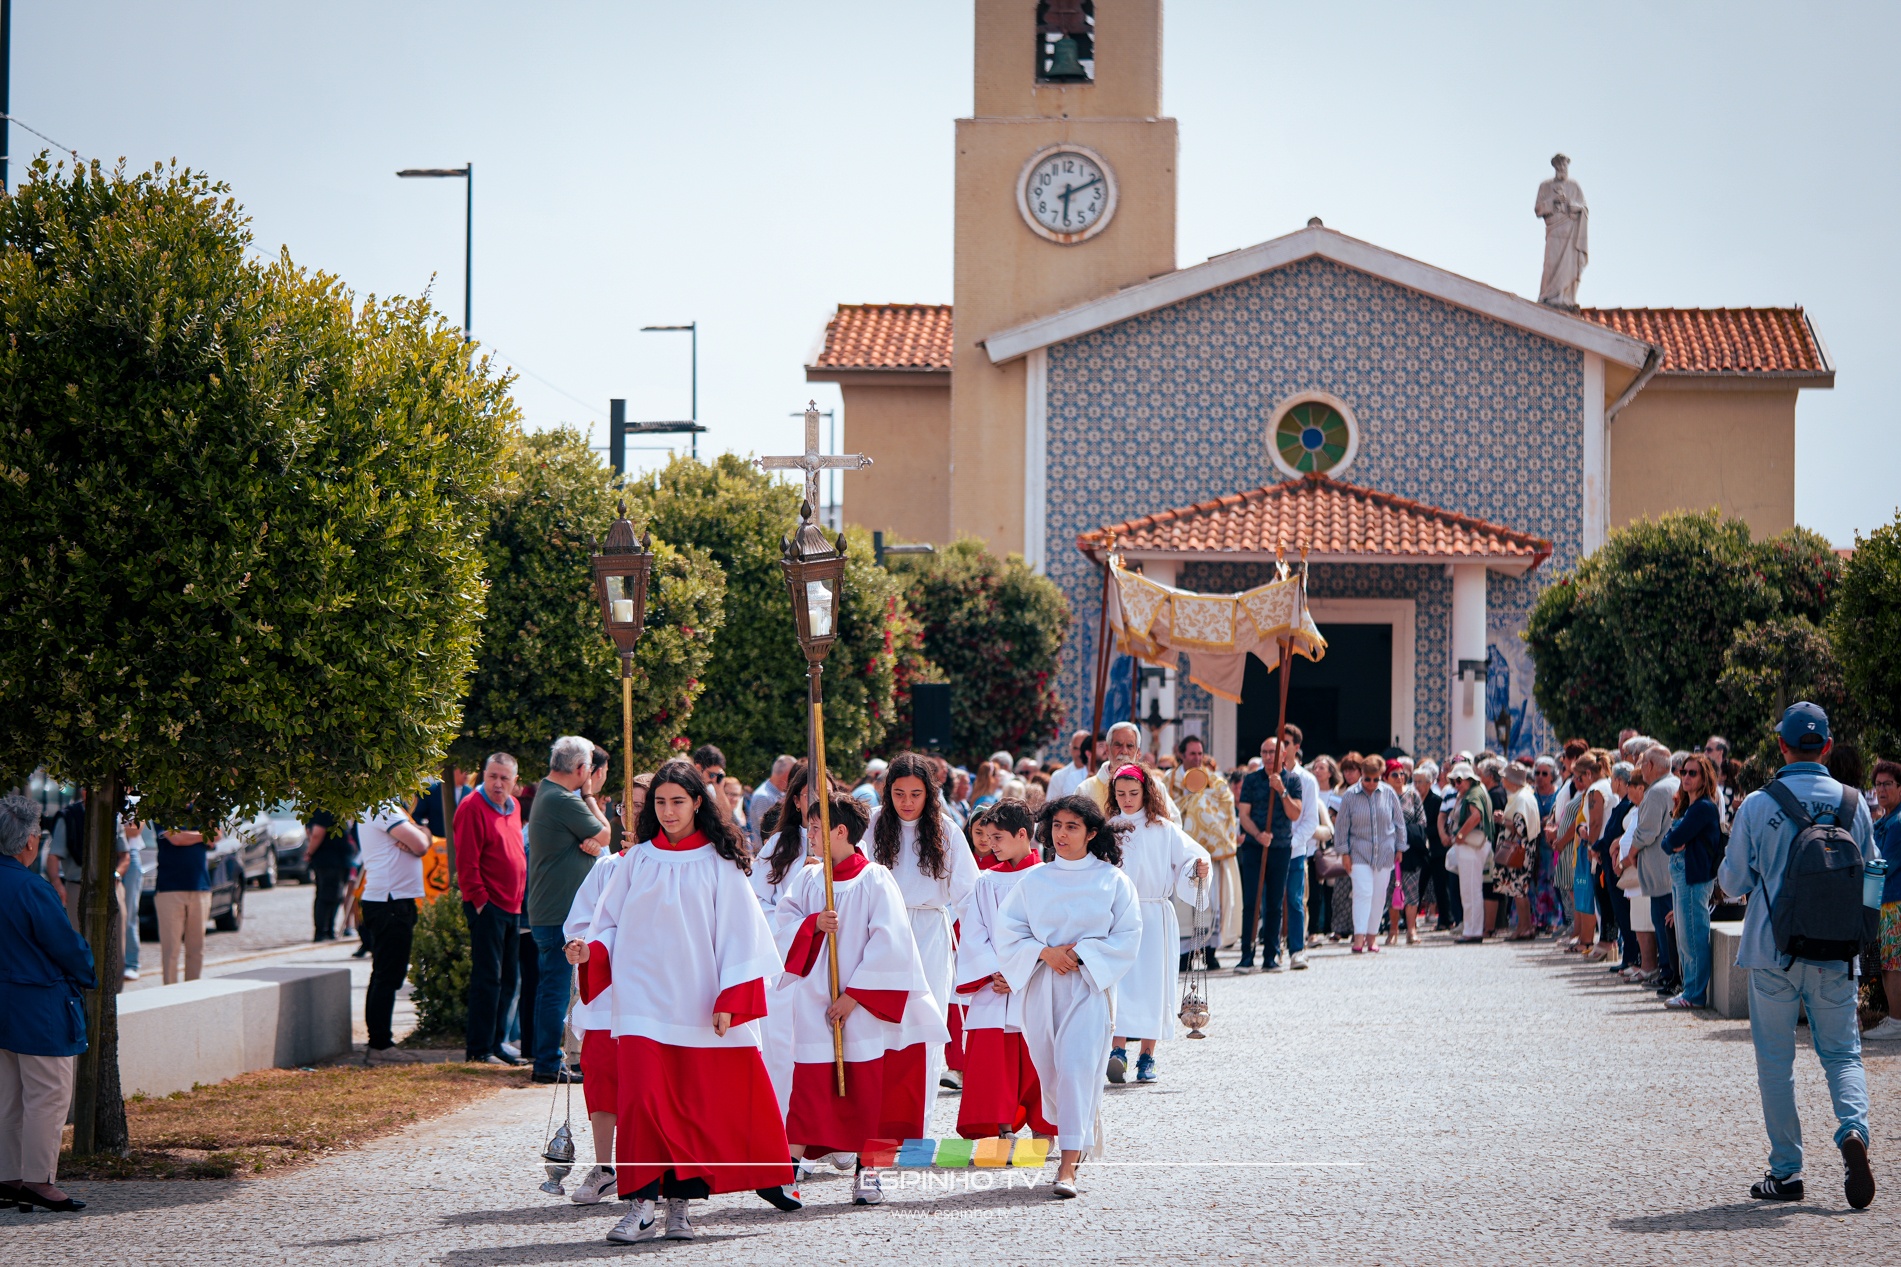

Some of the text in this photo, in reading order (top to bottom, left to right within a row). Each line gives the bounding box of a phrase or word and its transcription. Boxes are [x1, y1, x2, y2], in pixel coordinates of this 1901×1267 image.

[1052, 163, 1059, 176] 11
[1062, 160, 1074, 173] 12
[1080, 164, 1084, 177] 1
[1039, 173, 1051, 186] 10
[1034, 187, 1043, 200] 9
[1094, 187, 1102, 200] 3
[1039, 201, 1047, 213] 8
[1088, 202, 1096, 215] 4
[1051, 210, 1059, 223] 7
[1078, 211, 1086, 224] 5
